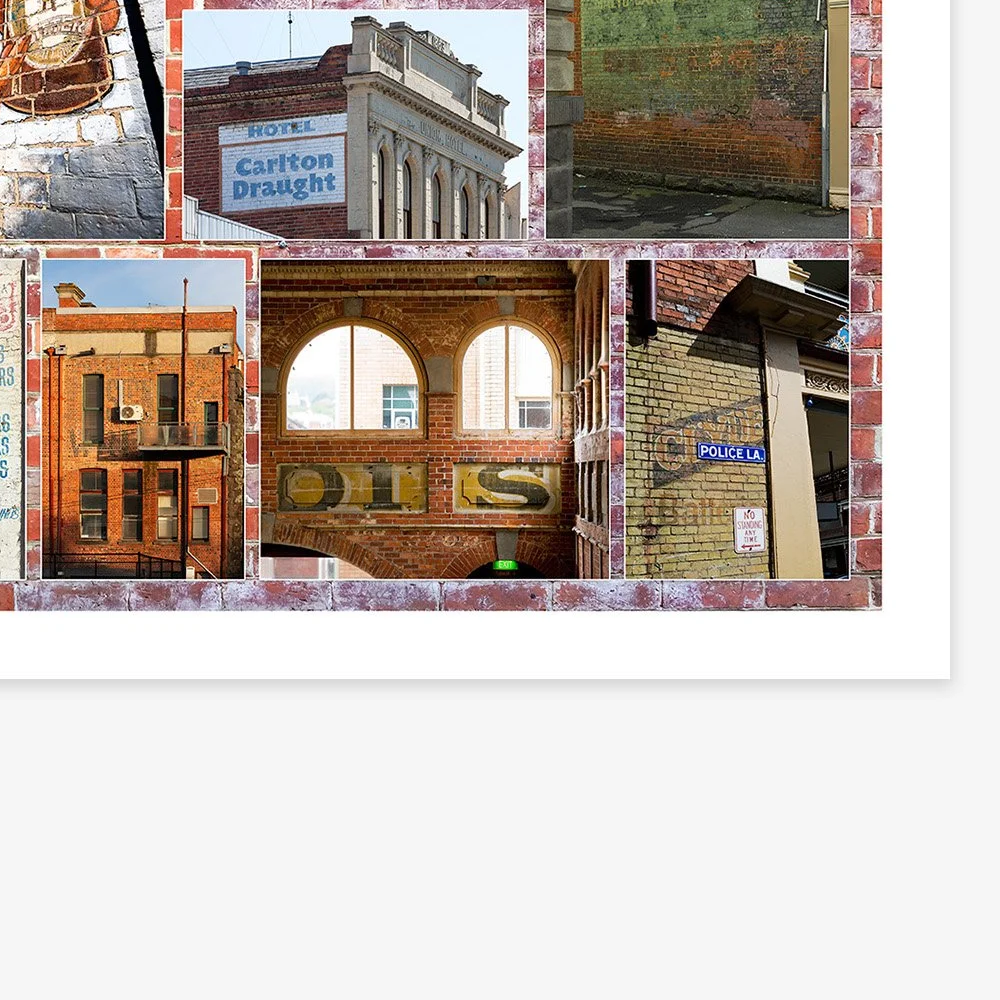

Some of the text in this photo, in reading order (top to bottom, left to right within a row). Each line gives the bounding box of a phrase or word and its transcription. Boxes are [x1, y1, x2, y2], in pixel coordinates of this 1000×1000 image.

[247, 119, 316, 139] HOTEL
[235, 151, 334, 177] Carlton
[233, 172, 336, 200] Draught
[700, 445, 764, 461] POLICE LA.
[743, 511, 756, 520] NO
[737, 521, 763, 530] STANDING
[498, 560, 513, 569] EXIT
